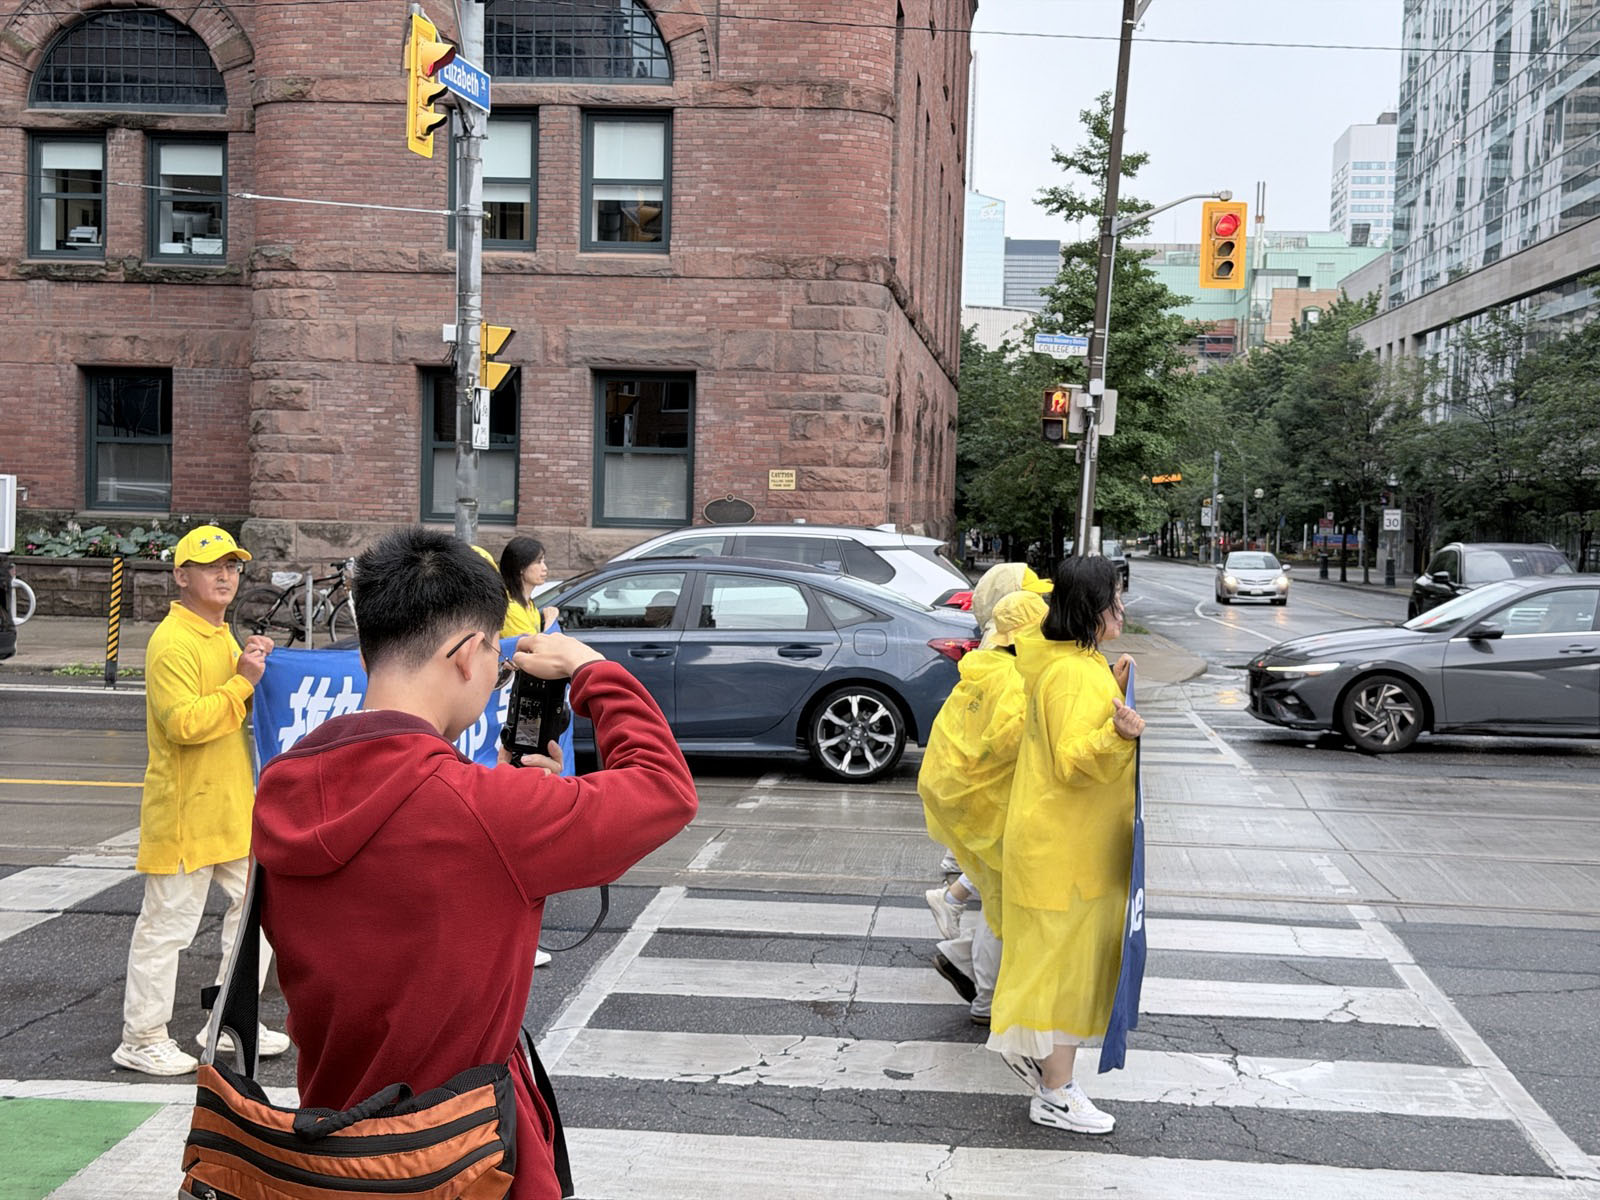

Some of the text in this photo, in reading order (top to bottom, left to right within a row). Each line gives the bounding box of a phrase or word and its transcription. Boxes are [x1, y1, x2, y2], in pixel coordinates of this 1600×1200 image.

[443, 63, 479, 97] Elizabeth
[1038, 344, 1081, 354] COLLEGE ST
[1385, 518, 1399, 528] 30
